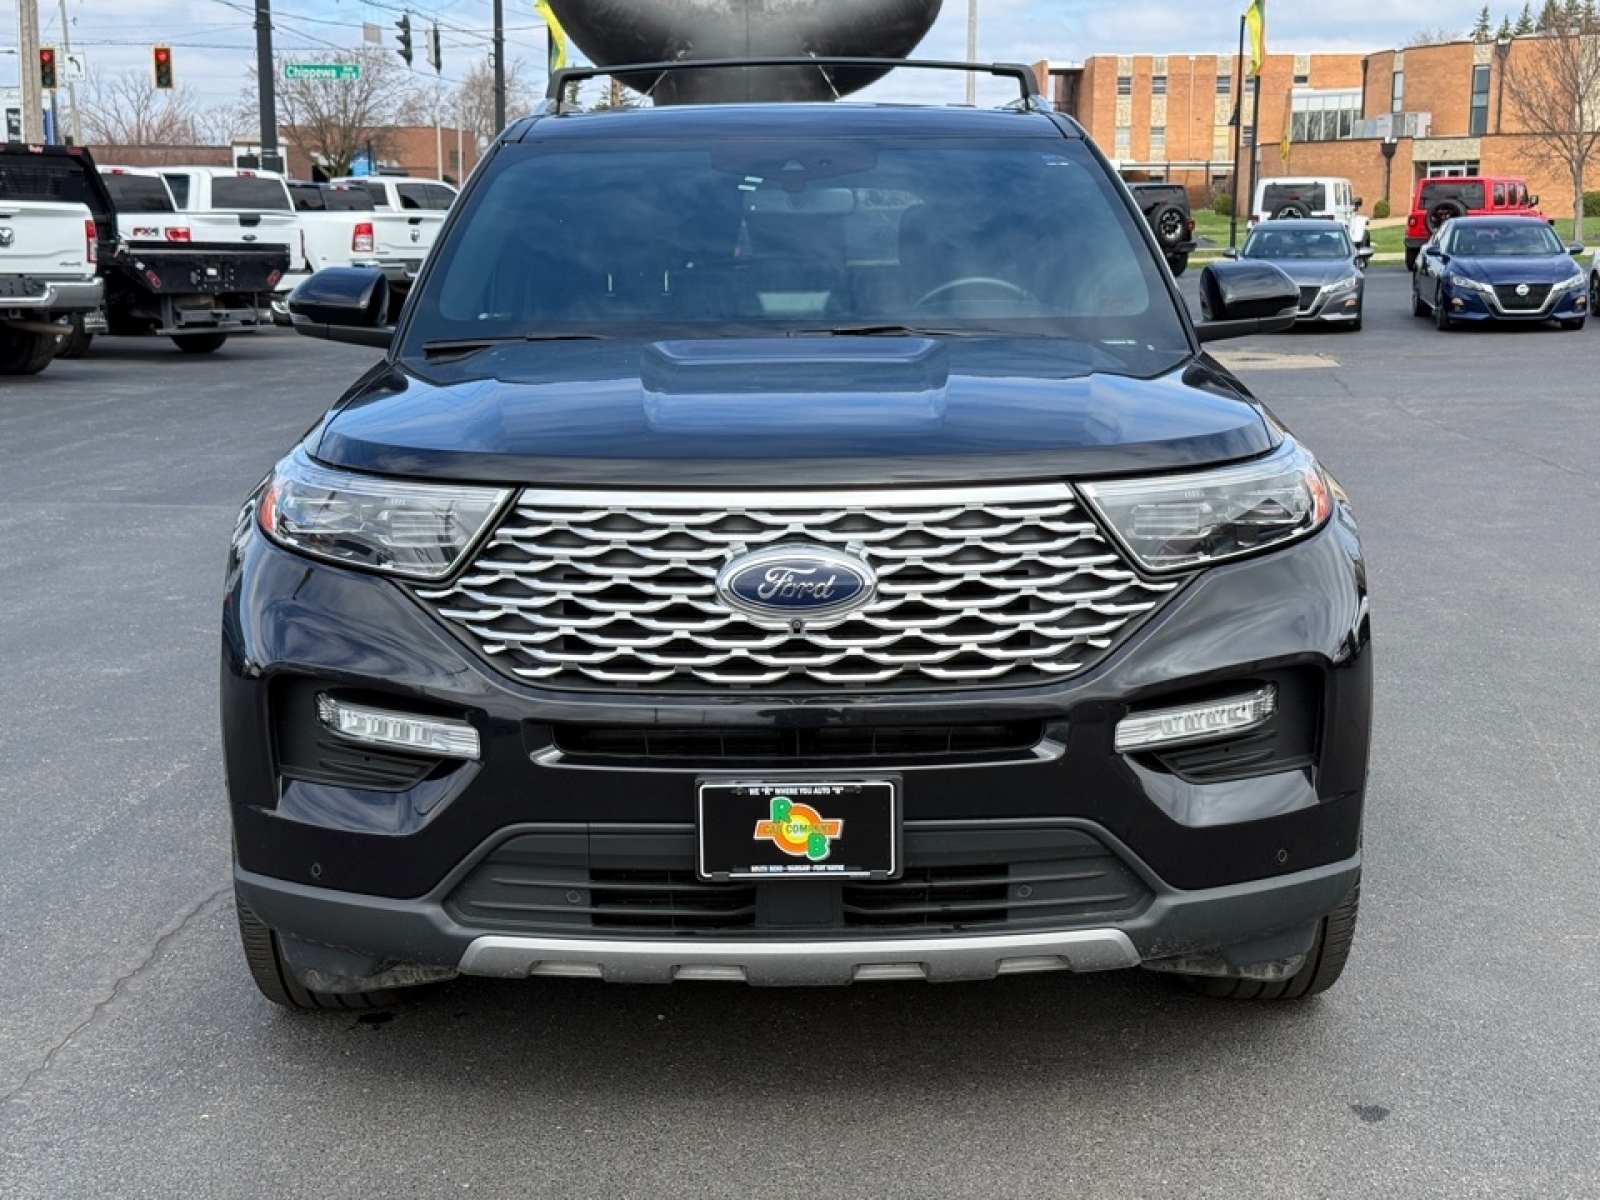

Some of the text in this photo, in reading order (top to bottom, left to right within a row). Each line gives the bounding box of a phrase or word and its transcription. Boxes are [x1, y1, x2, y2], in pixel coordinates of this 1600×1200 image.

[286, 66, 337, 80] Chippewa
[132, 227, 159, 237] FX4
[757, 567, 837, 599] Ford
[774, 787, 799, 796] WHERE
[799, 787, 813, 796] YOU
[813, 786, 831, 796] AUTO
[770, 797, 793, 824] R
[807, 832, 830, 861] B
